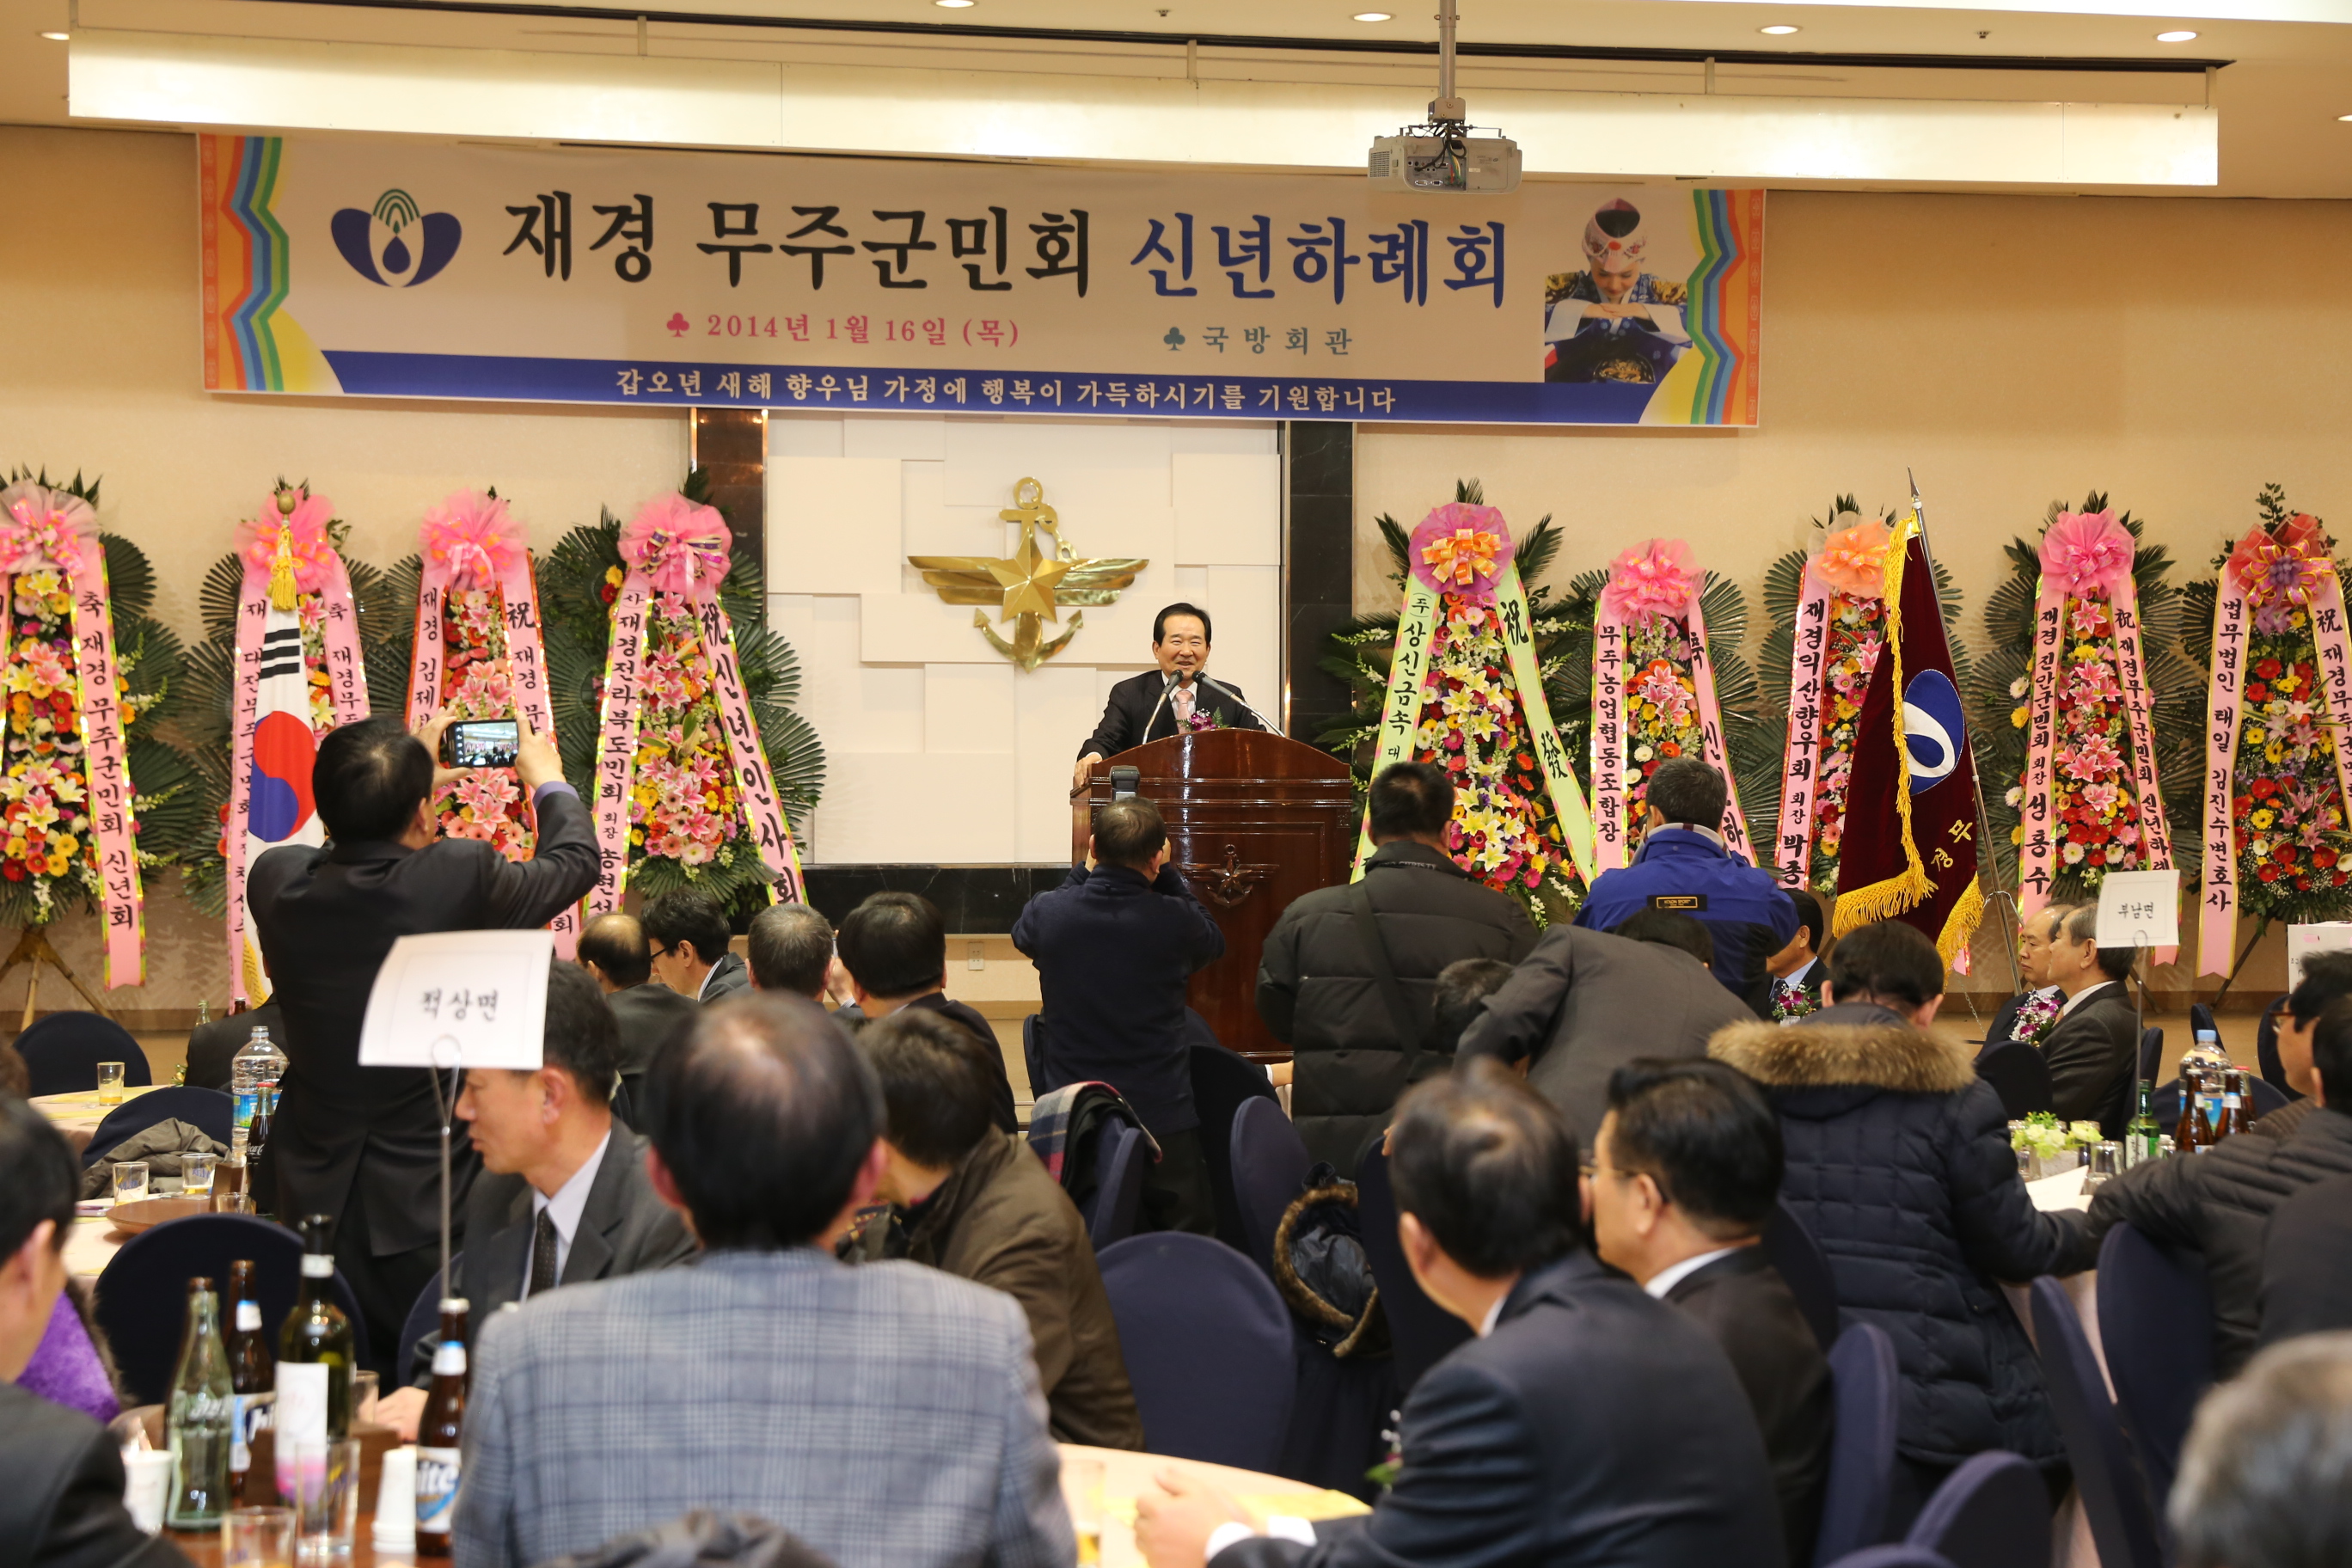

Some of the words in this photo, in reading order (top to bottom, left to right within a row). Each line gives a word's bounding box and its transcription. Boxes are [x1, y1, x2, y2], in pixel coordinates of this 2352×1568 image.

[503, 190, 655, 285] 재경
[697, 201, 1089, 298] 무주군민회
[1130, 212, 1507, 309] 신년하례회
[707, 314, 811, 342] 2014년
[826, 315, 870, 344] 1월
[885, 318, 946, 346] 16일
[962, 318, 1020, 348] (목)
[1202, 326, 1353, 356] 국방회관
[616, 369, 702, 398] 갑오년
[716, 372, 772, 400] 새해
[785, 372, 870, 402] 향우님
[884, 376, 967, 404] 가정에
[981, 378, 1063, 406] 행복이
[1076, 380, 1246, 411] 가득하시기를
[1258, 384, 1396, 413] 기원합니다
[78, 591, 105, 618] 축
[422, 587, 438, 640] 재경
[506, 602, 535, 629] 祝
[701, 603, 730, 647] 祝
[1500, 599, 1529, 646] 祝
[2114, 609, 2136, 629] 祝
[2315, 608, 2343, 634] 祝
[2038, 607, 2059, 646] 재경
[2217, 597, 2244, 693] 법무법인
[81, 630, 106, 685] 재경
[514, 646, 536, 689] 재경
[1788, 598, 1825, 782] 재경익산향우회
[1597, 625, 1621, 843] 무주농업협동조합장
[2213, 706, 2234, 754] 태일
[88, 697, 122, 836] 무주군민회
[2030, 756, 2048, 786] 회장
[603, 812, 618, 839] 회장
[1790, 791, 1807, 825] 회장
[1781, 833, 1808, 891] 박종
[104, 849, 133, 930] 신년회
[2117, 901, 2155, 920] 부남면
[421, 988, 499, 1021] 적상면
